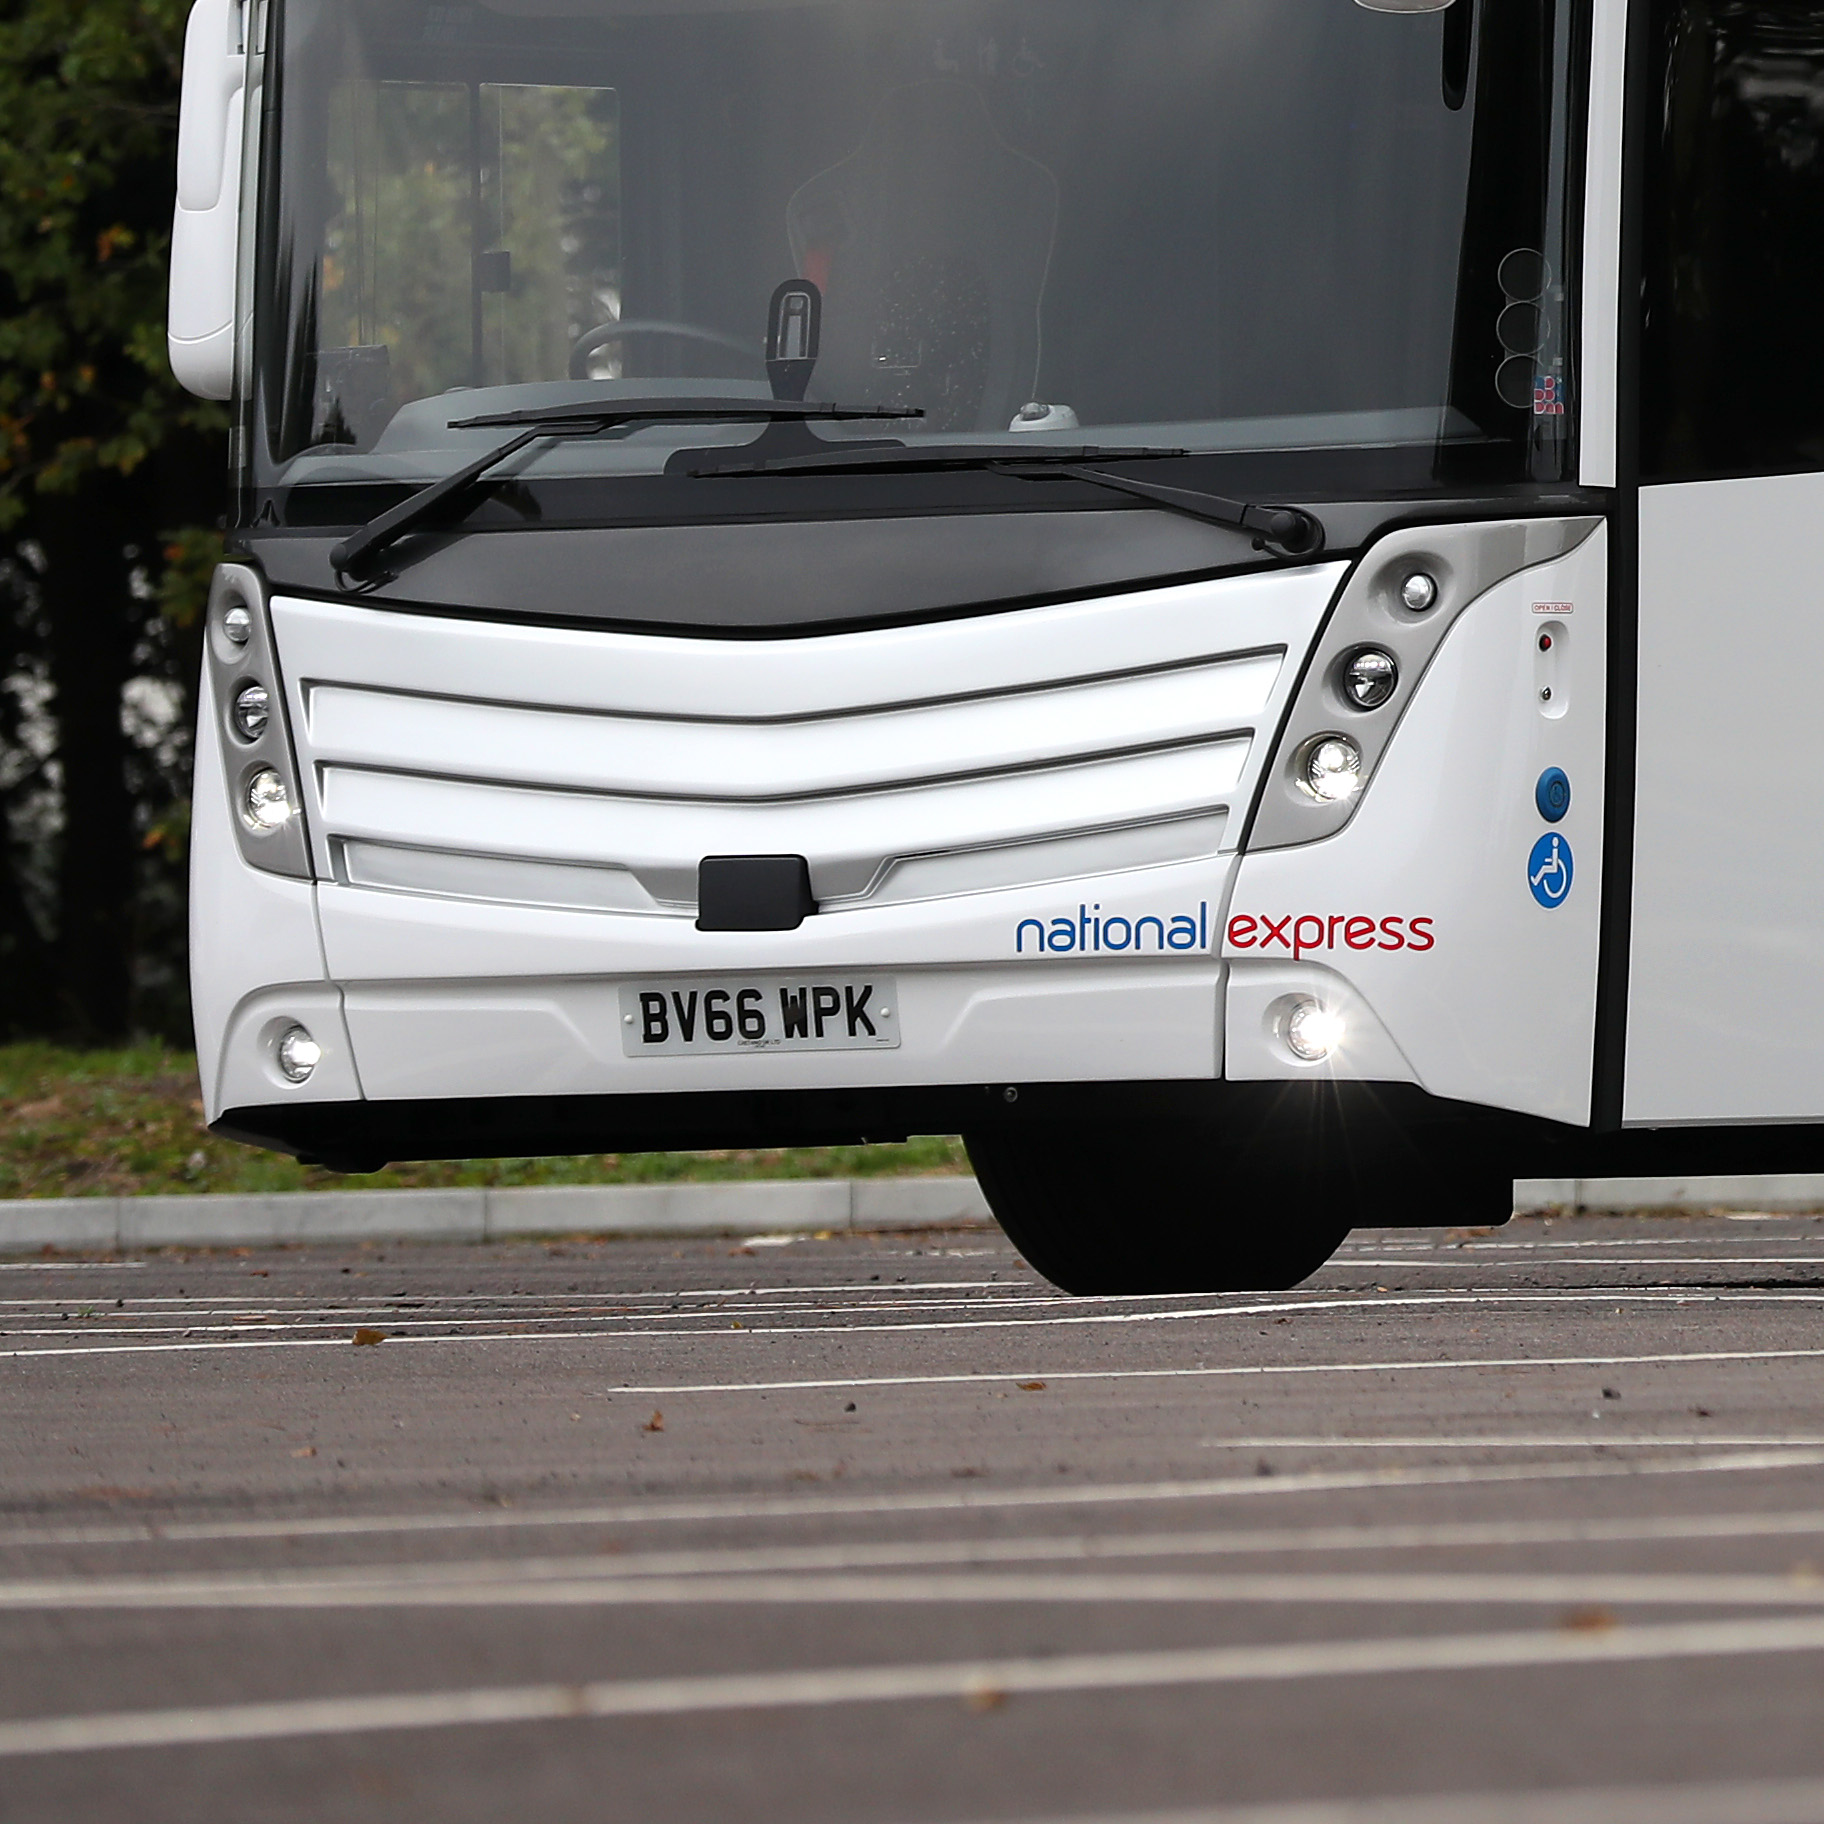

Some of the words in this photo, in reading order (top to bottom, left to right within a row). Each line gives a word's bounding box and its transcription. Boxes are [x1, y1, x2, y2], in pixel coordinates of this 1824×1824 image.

[1016, 902, 1206, 952] national
[1228, 914, 1435, 961] express
[639, 988, 769, 1048] BV66
[775, 984, 881, 1042] WPK
